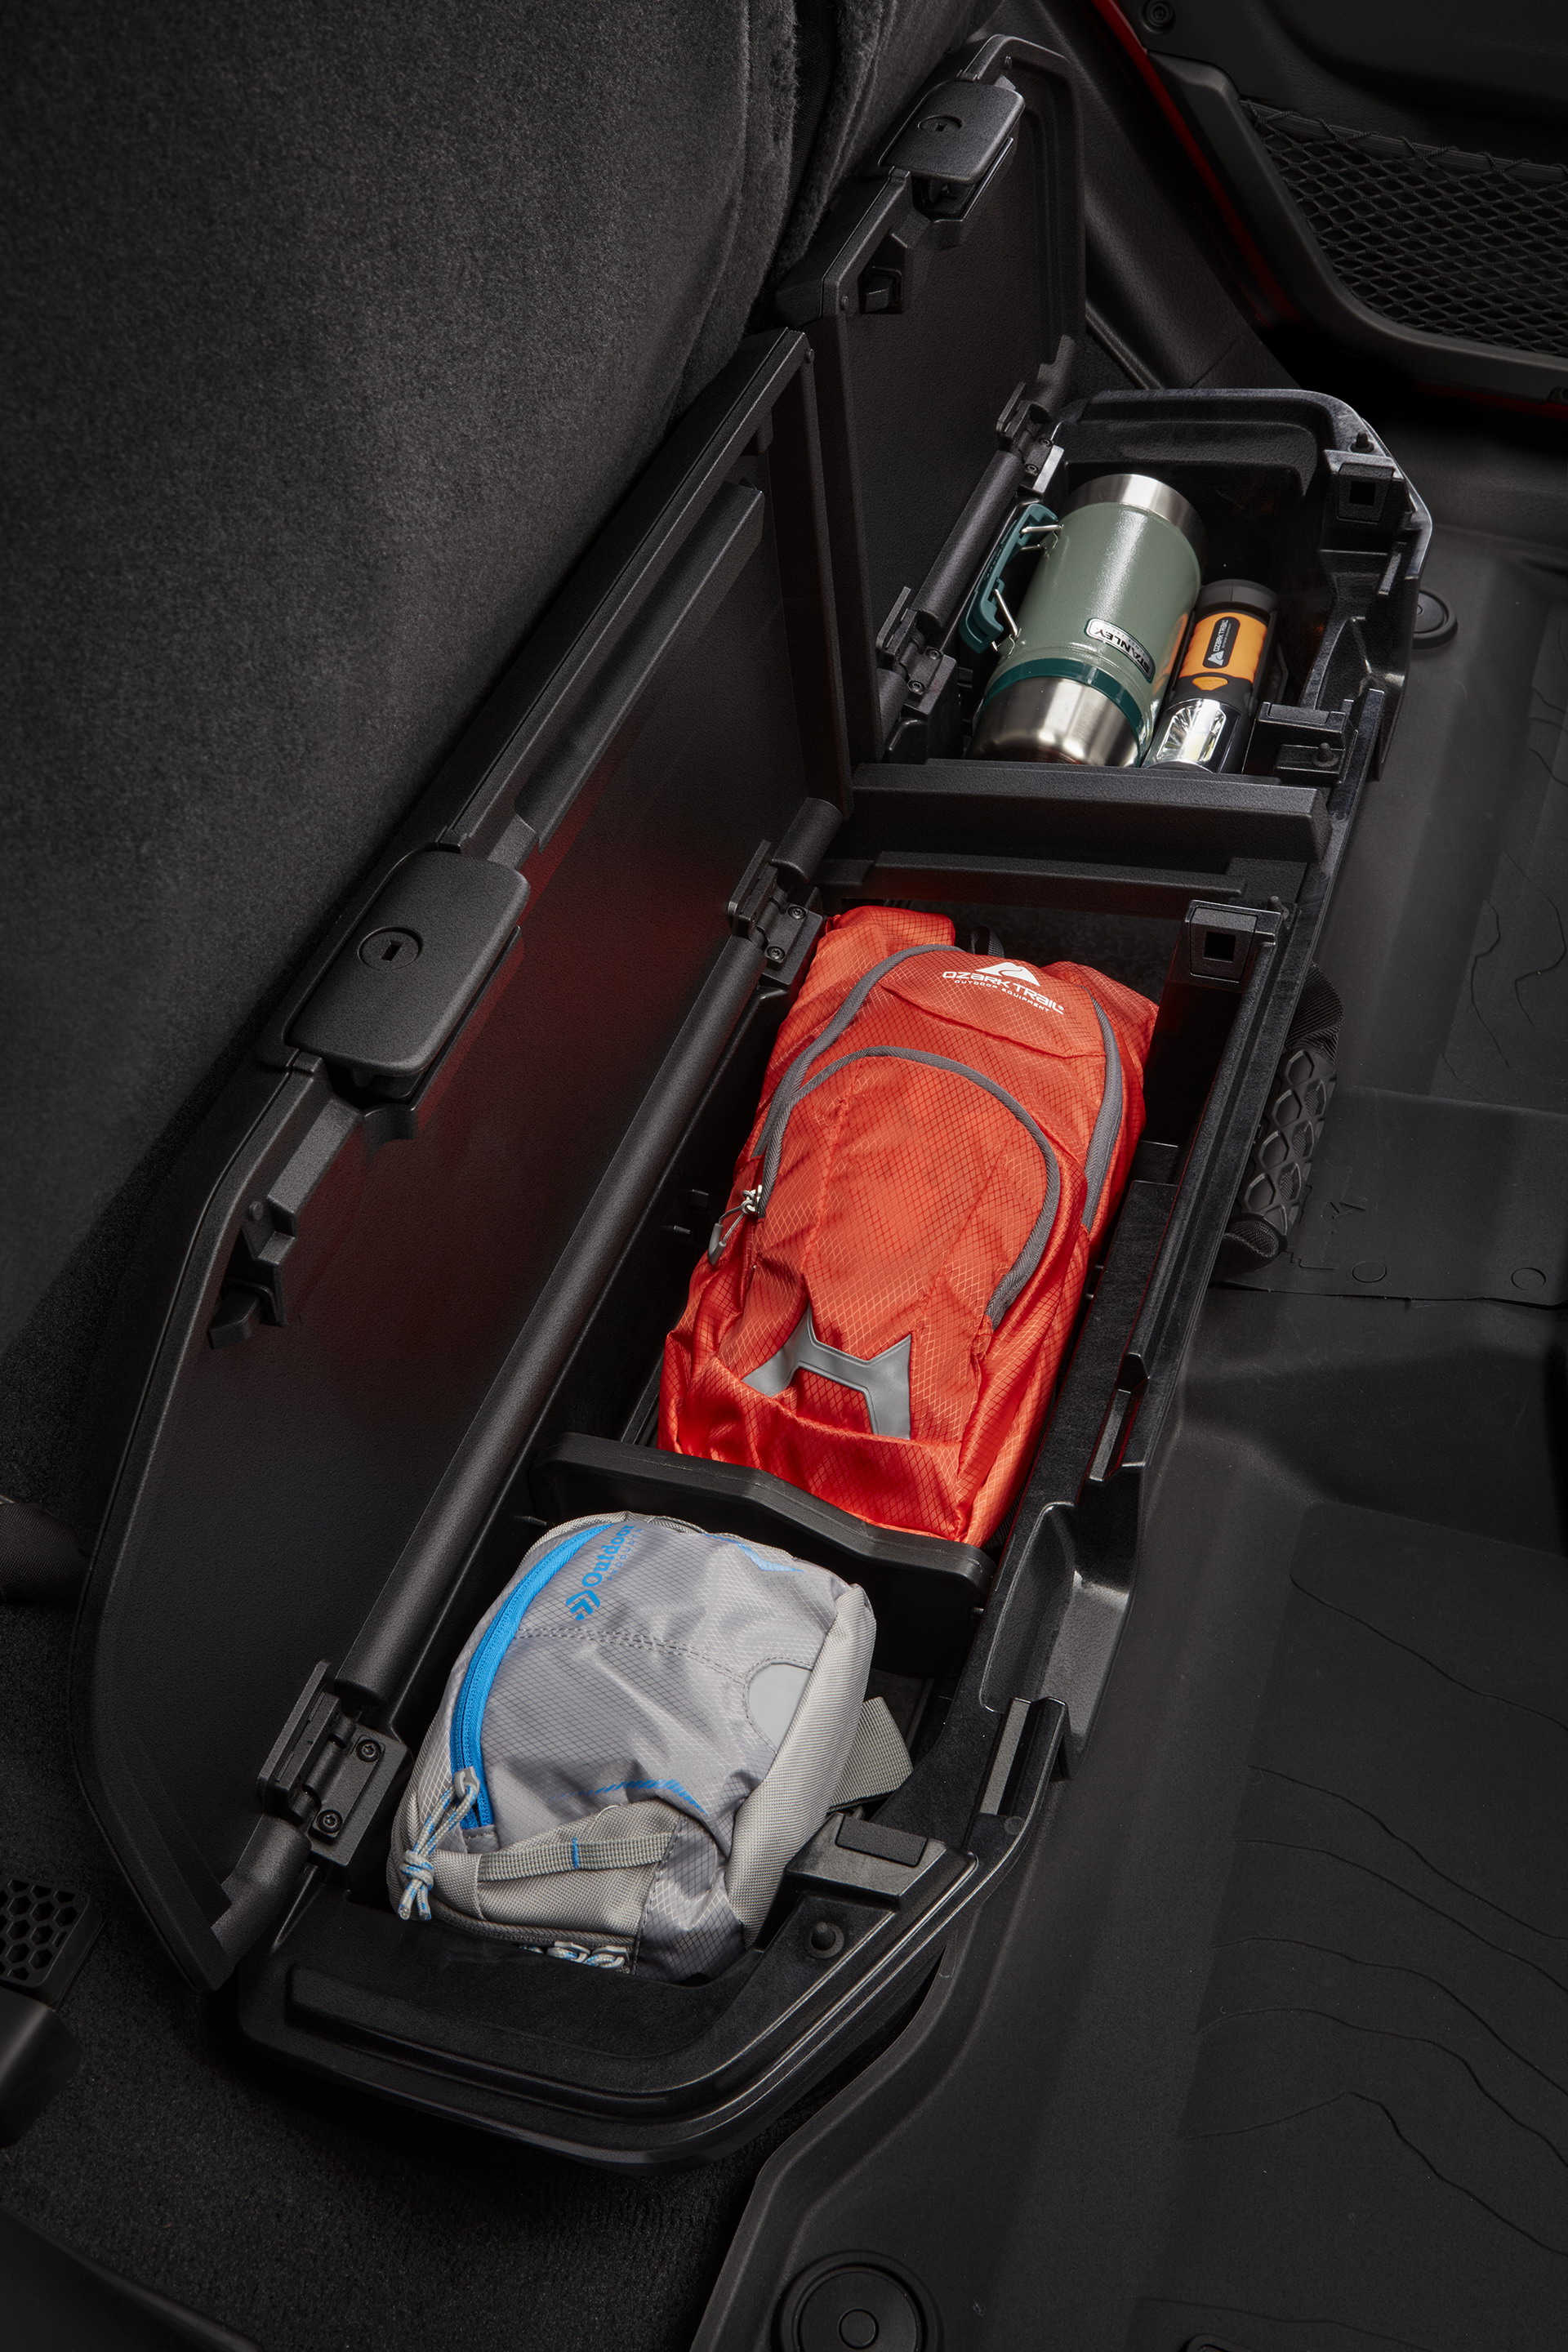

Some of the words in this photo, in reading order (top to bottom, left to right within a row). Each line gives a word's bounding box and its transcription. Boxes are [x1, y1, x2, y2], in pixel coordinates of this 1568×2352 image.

[1094, 629, 1151, 675] STANLEY
[954, 980, 998, 989] OUTDOOR
[1001, 988, 1050, 1013] EQUIPMENT
[581, 1525, 636, 1588] Outdoor
